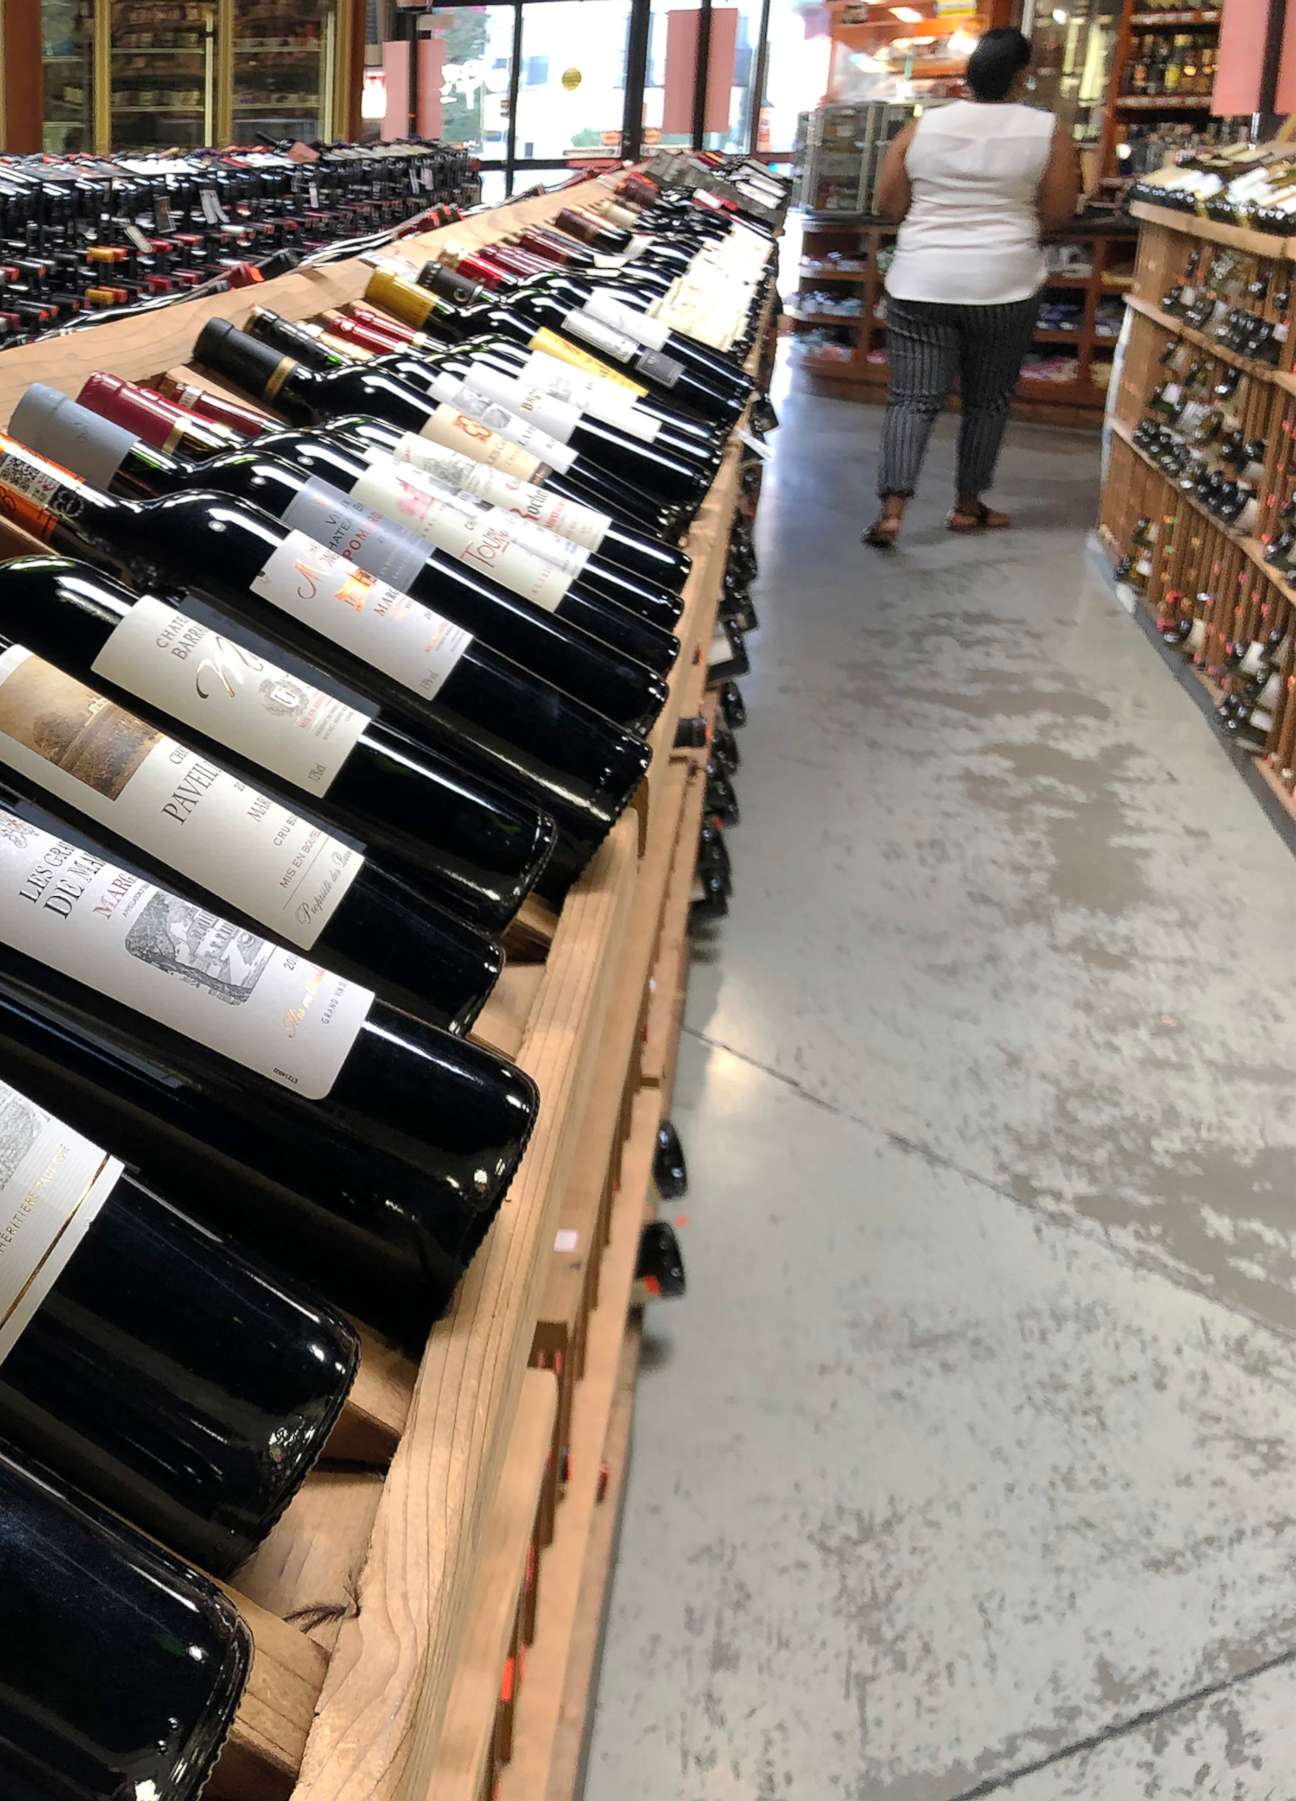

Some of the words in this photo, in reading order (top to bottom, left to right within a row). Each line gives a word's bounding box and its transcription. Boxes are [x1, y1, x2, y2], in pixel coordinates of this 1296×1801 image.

[156, 615, 189, 649] CHATE
[18, 865, 53, 904] LES
[280, 865, 296, 888] MIS
[293, 852, 306, 868] EN
[43, 878, 85, 920] DE
[93, 872, 138, 920] MARG
